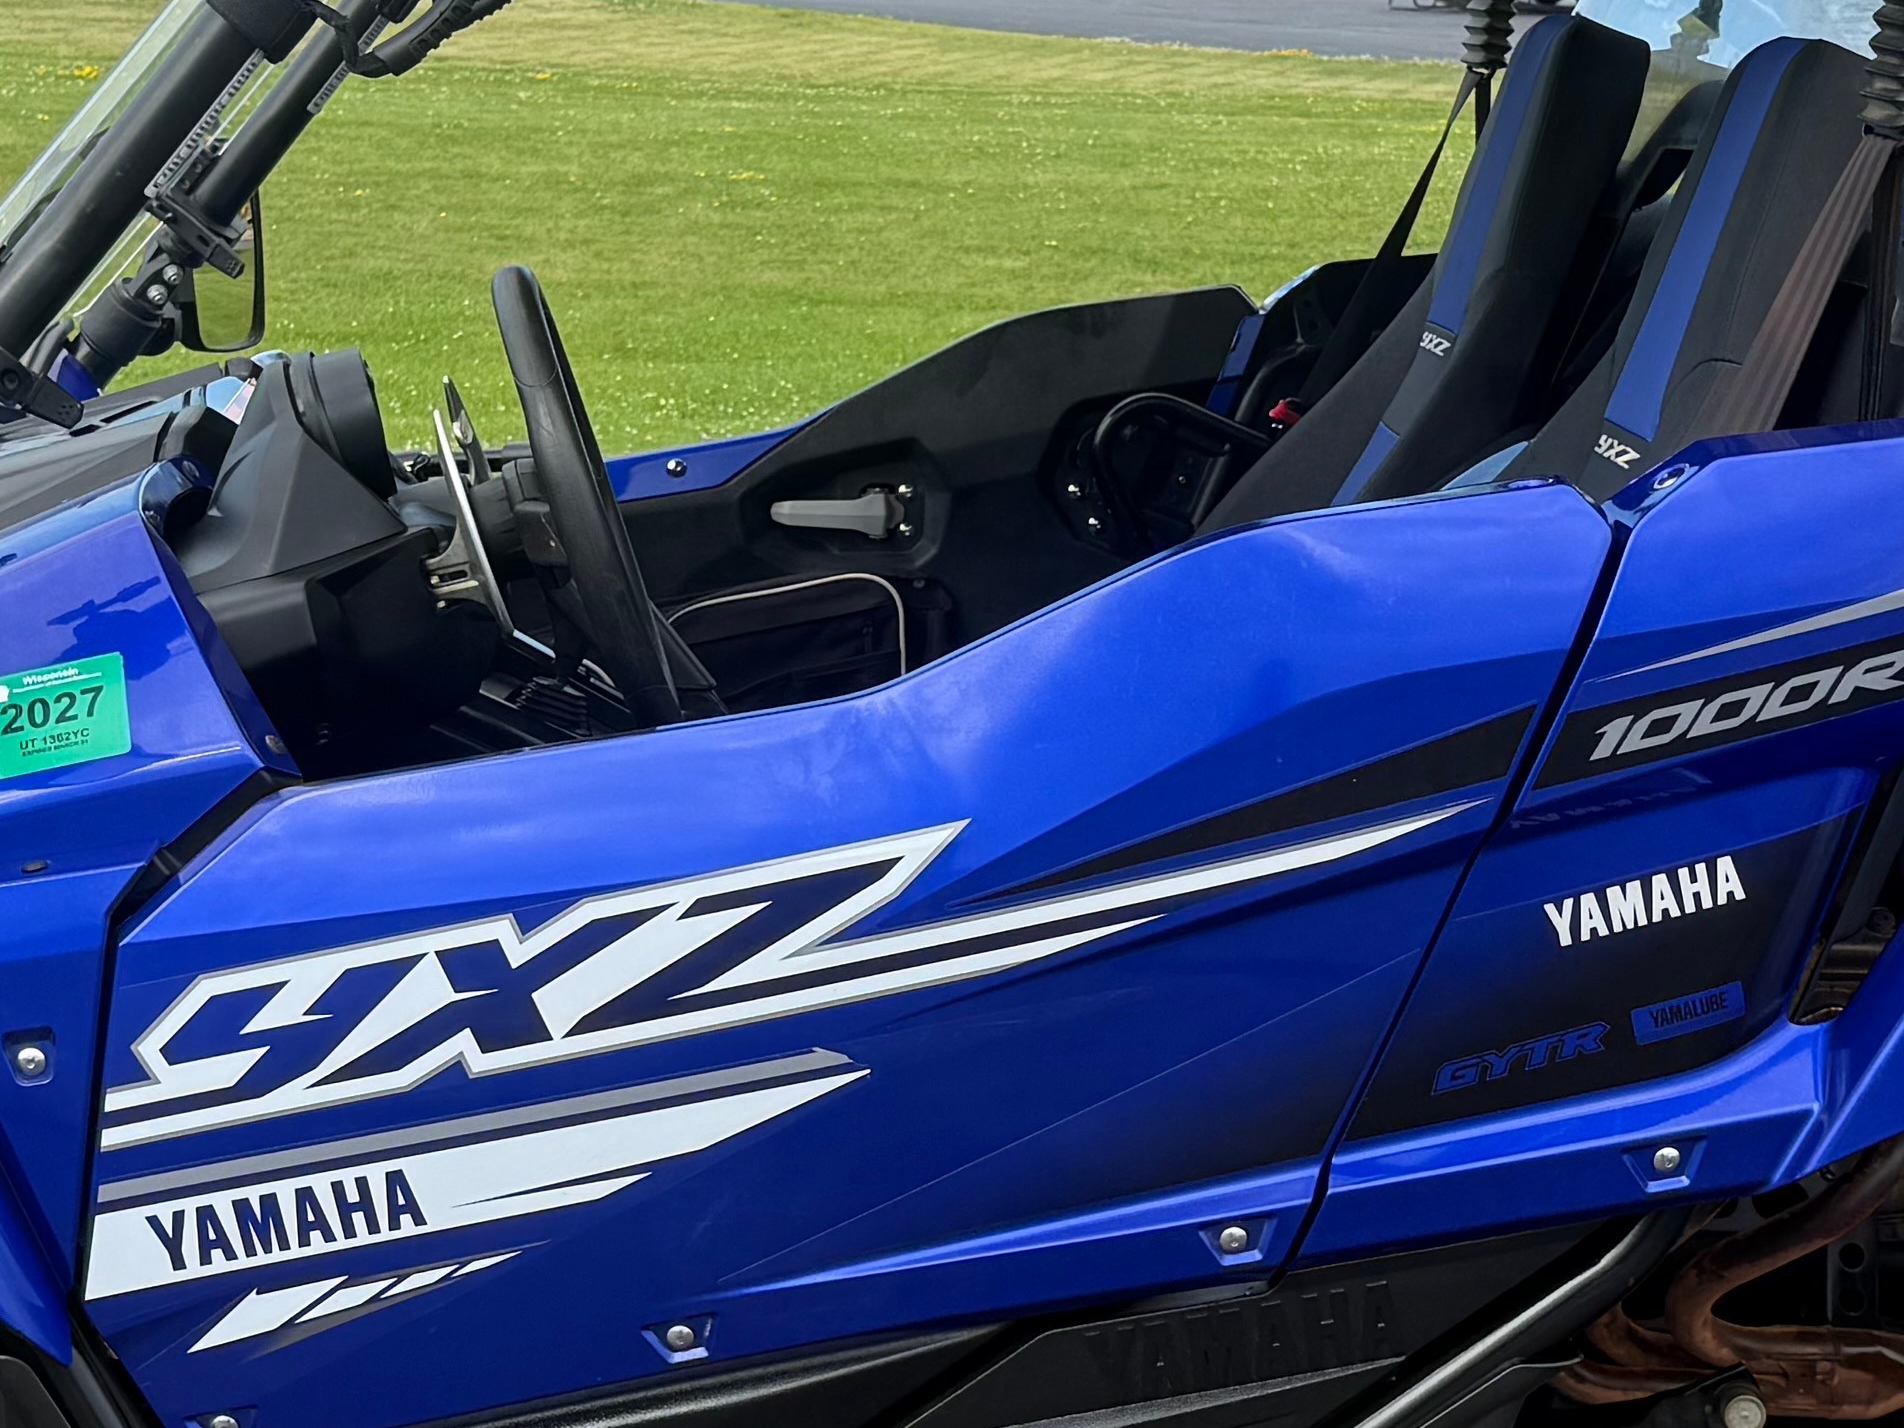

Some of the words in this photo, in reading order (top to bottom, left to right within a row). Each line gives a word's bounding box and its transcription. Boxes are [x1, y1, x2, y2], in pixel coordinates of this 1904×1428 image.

[1593, 434, 1641, 470] YXZ
[0, 684, 104, 735] 2027
[19, 738, 37, 751] UT
[1543, 855, 1746, 947] YAMAHA
[1649, 990, 1729, 1029] YAMALUBE
[1431, 1021, 1611, 1095] GYTR
[145, 1168, 428, 1273] YAMAHA
[1082, 1279, 1407, 1402] YAMAHA
